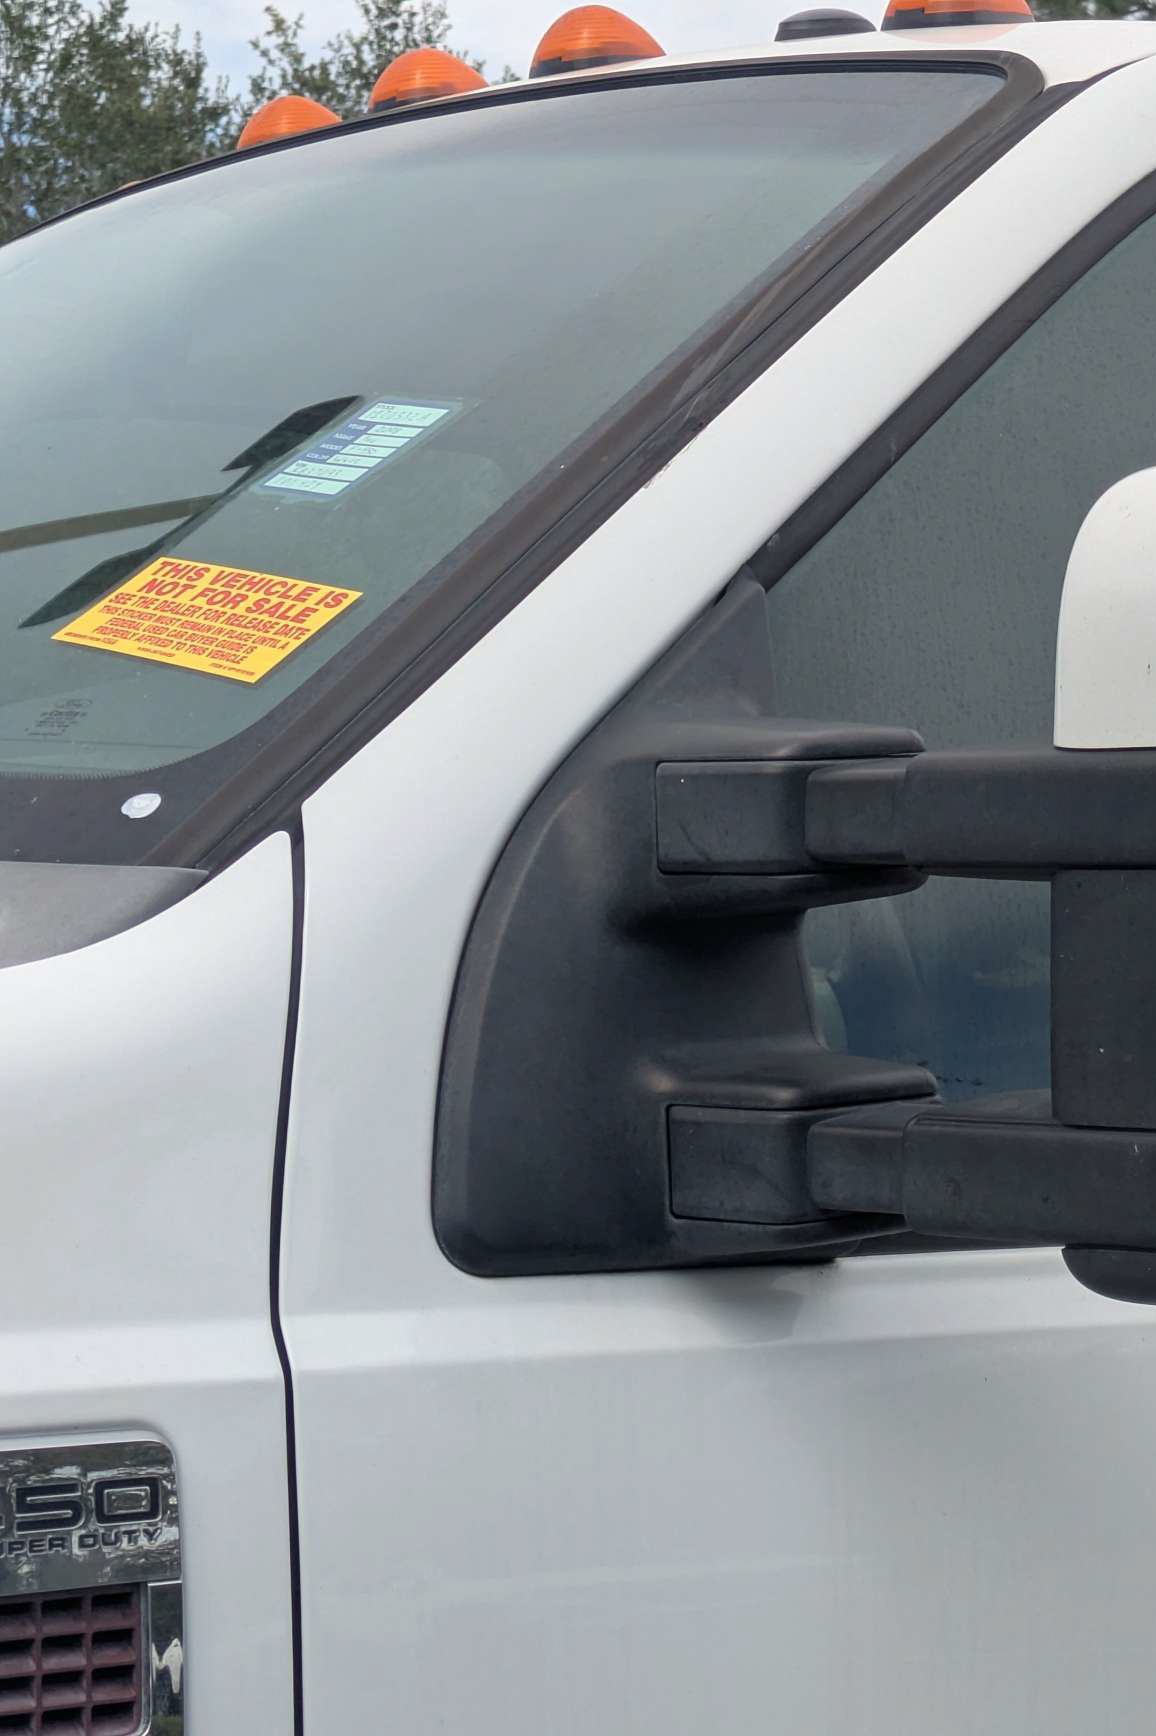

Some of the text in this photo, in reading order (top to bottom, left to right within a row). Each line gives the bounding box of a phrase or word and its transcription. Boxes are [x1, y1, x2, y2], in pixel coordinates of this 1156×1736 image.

[136, 578, 319, 624] NOT FOR SALE
[152, 561, 349, 608] THIS VEHICLE IS
[99, 605, 289, 650] THIS STICKER MUST REMAIN IN PLACE UNTIL A
[108, 592, 310, 640] SEE THE DEALER FOR RELEASE DATE
[0, 1476, 162, 1534] 50
[78, 1528, 162, 1551] DUTY
